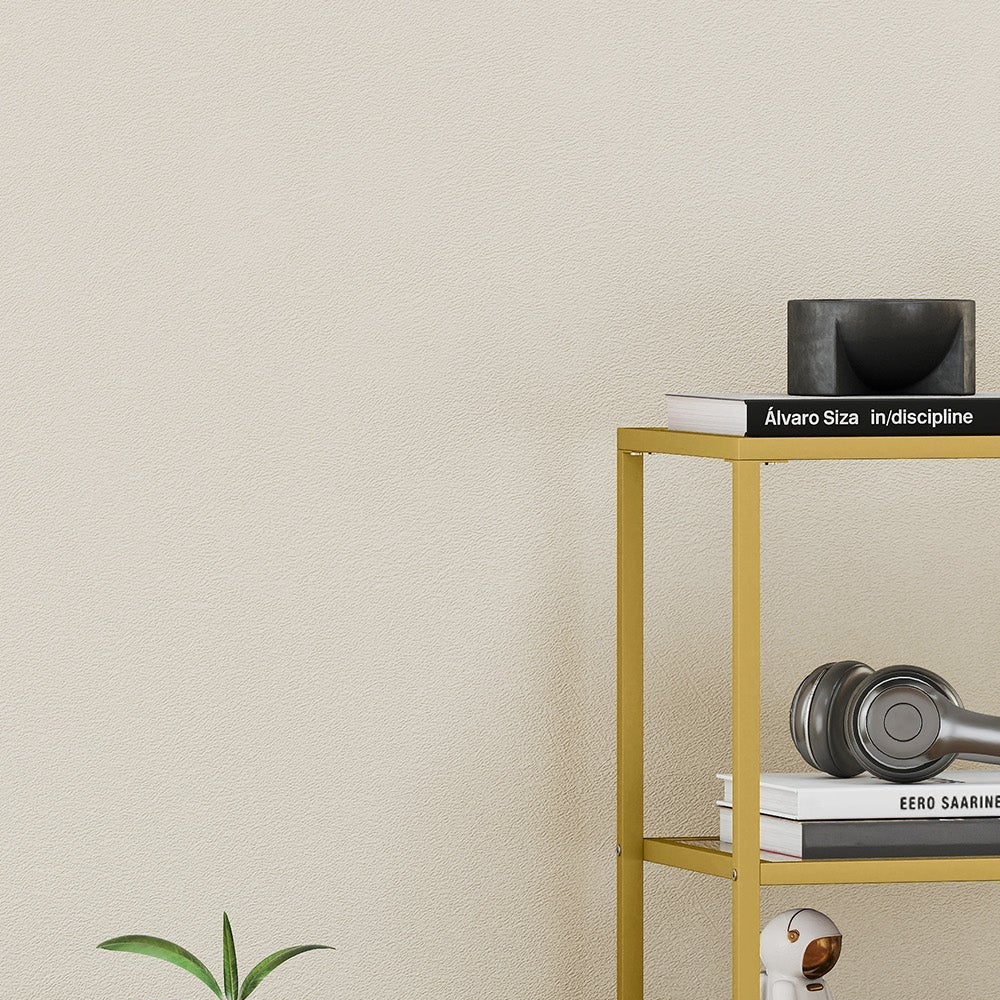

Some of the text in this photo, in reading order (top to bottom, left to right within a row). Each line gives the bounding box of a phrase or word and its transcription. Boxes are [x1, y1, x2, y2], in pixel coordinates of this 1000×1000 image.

[764, 407, 974, 428] Álvaro Siza in/discipline
[900, 796, 935, 810] EERO
